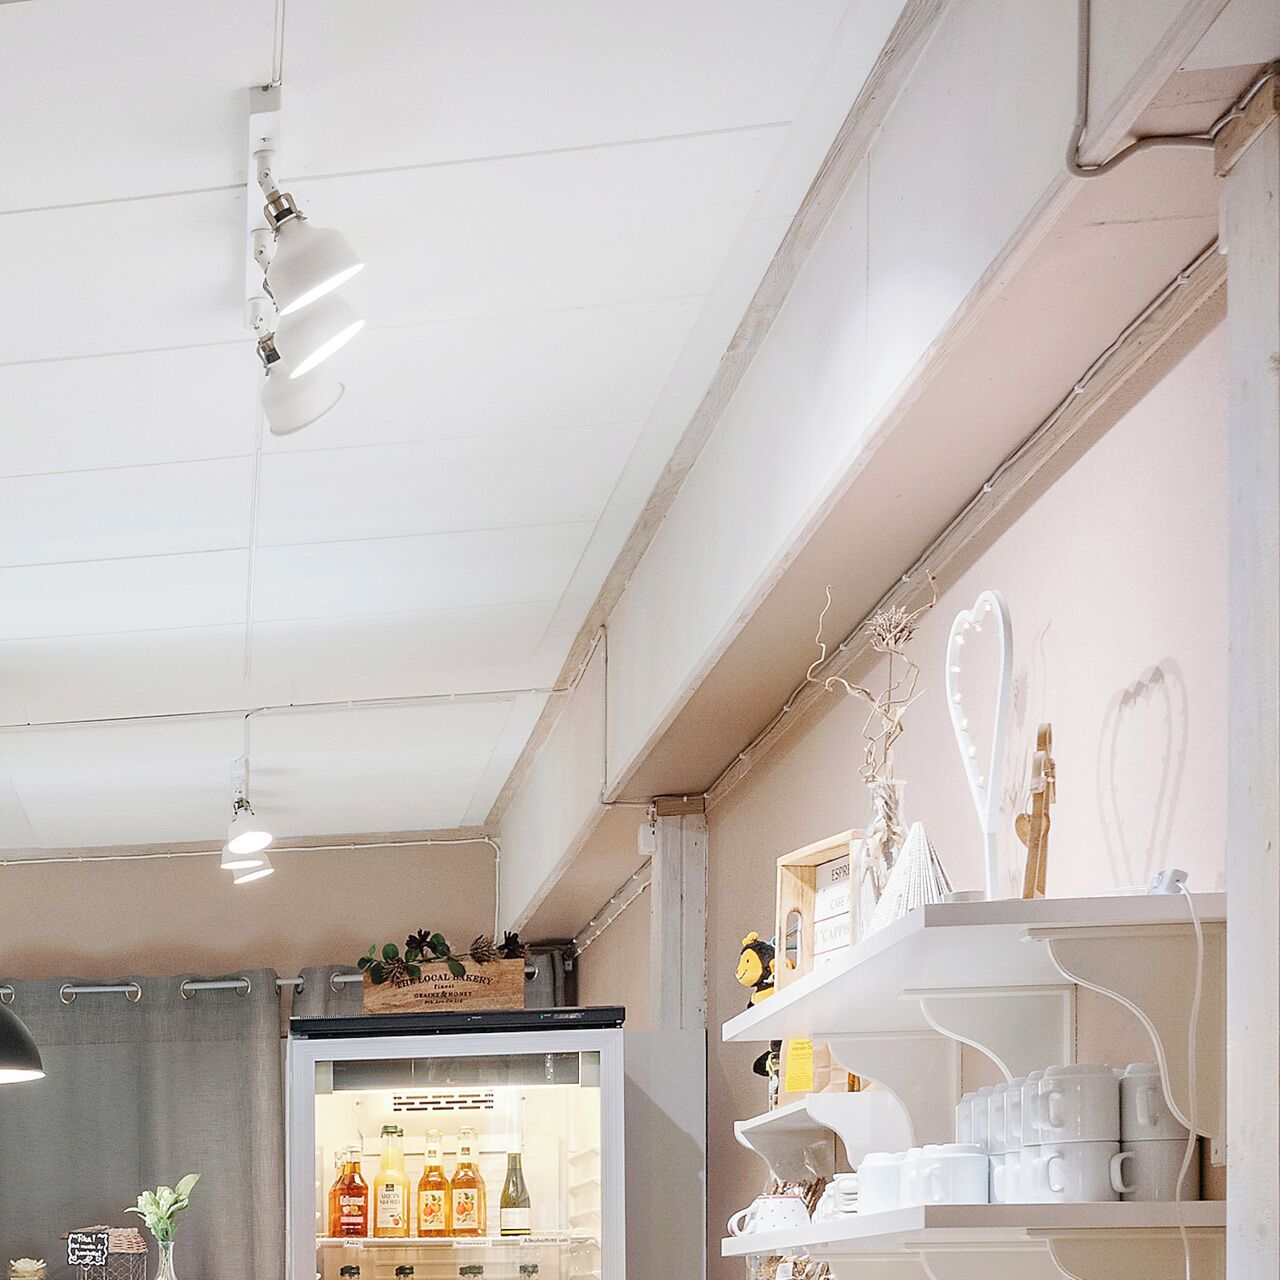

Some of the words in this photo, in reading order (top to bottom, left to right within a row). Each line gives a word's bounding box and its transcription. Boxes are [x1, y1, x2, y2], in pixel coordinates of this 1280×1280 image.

[394, 978, 416, 989] THE
[419, 973, 451, 984] LOCAL
[453, 974, 494, 985] BAKERY
